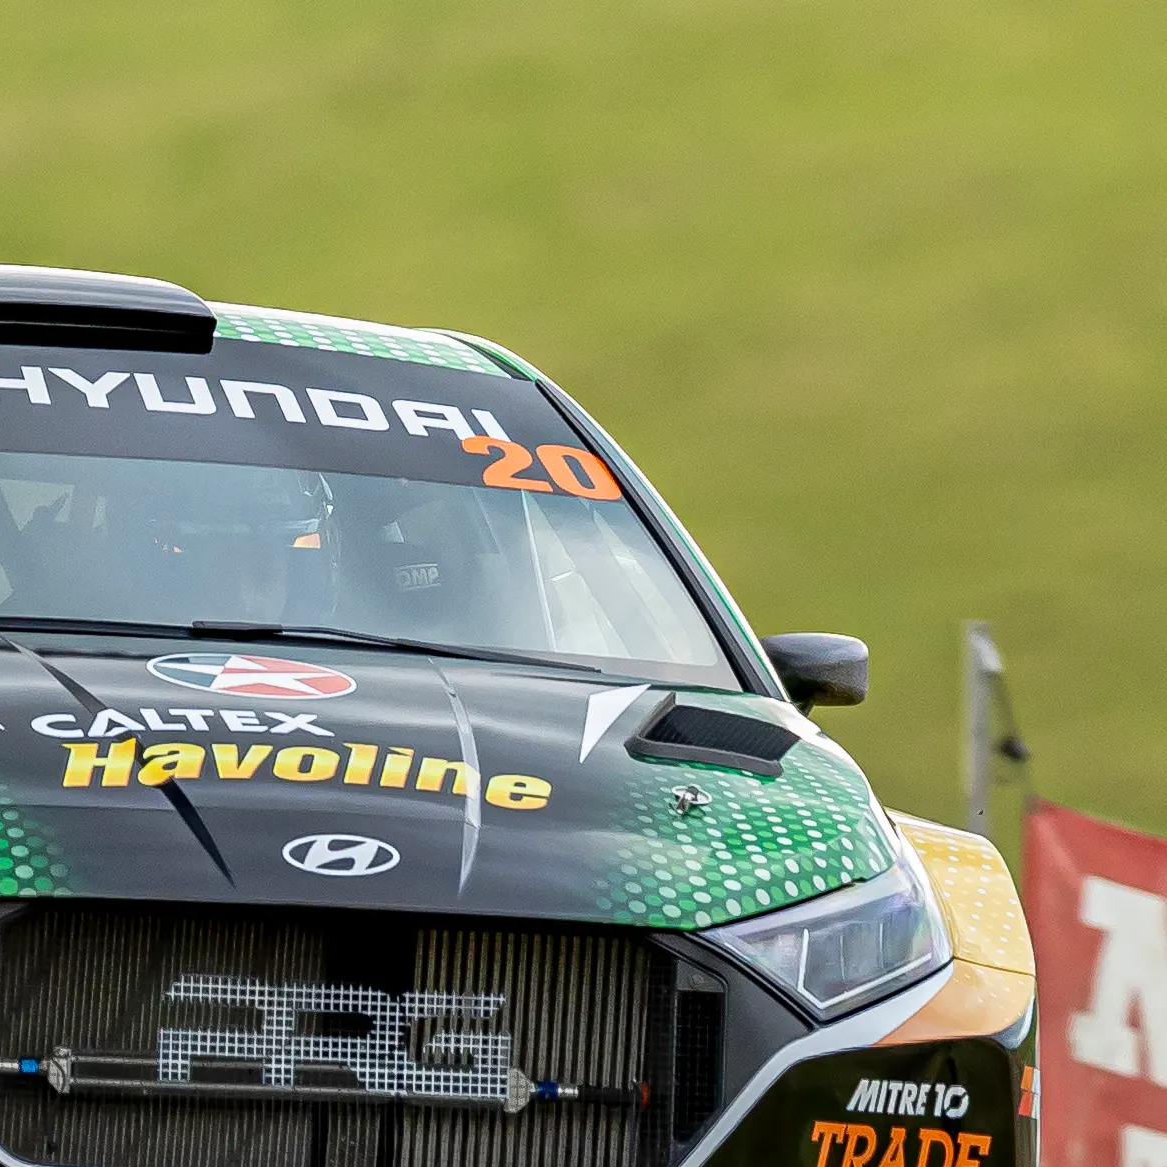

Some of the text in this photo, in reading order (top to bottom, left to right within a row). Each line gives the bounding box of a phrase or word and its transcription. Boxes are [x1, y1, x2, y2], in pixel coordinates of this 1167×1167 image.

[461, 435, 623, 500] 20
[31, 708, 335, 738] CALTEX
[61, 737, 553, 810] Havoline
[846, 1078, 970, 1119] MITRE 10
